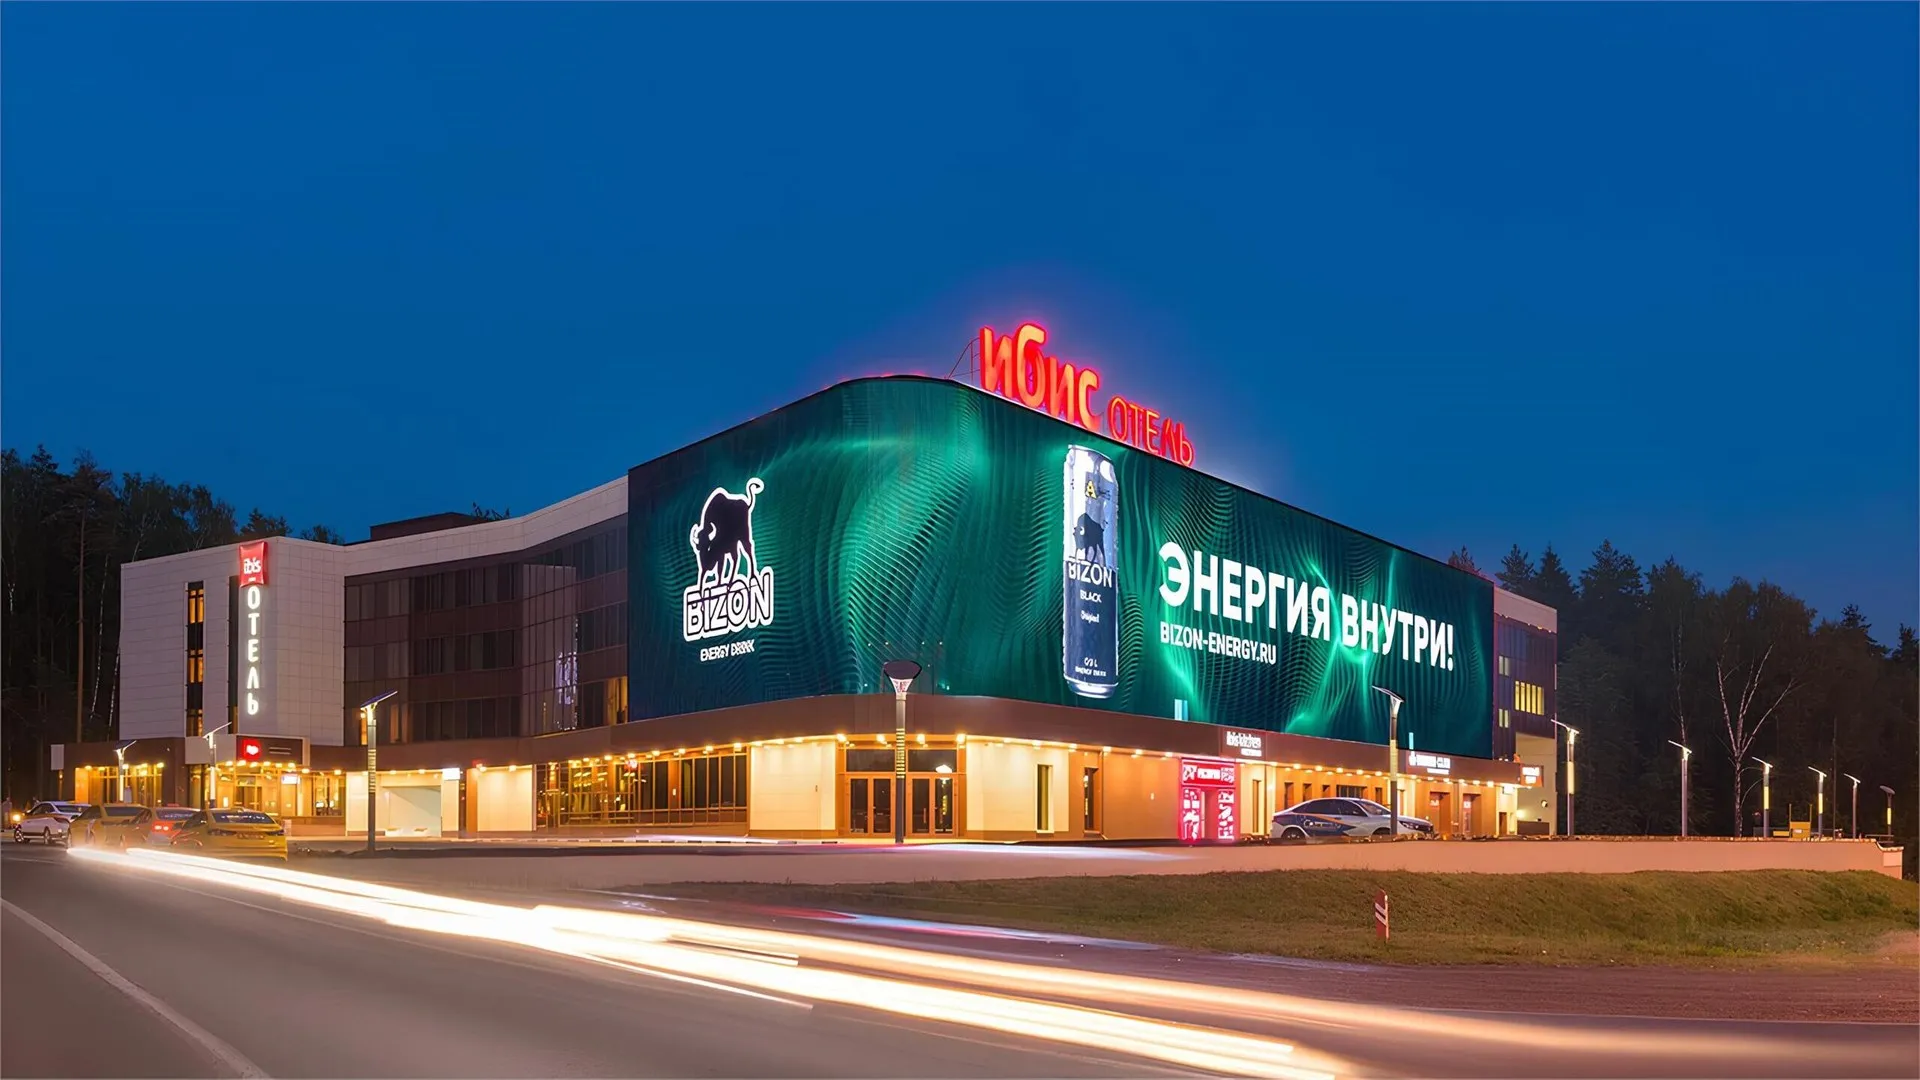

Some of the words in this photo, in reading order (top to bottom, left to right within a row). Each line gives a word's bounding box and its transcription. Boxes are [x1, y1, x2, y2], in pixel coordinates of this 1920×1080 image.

[1107, 395, 1194, 467] ОТЕЛЬ
[243, 557, 262, 574] ibis
[1068, 559, 1112, 588] BIZON
[684, 566, 774, 641] BIZON
[1159, 541, 1331, 641] ЭНЕРГИЯ
[1341, 593, 1454, 671] ВНУТРИ!
[247, 586, 260, 715] ОТЕЛЬ
[1160, 621, 1276, 665] BIZON-ENERGY.RU
